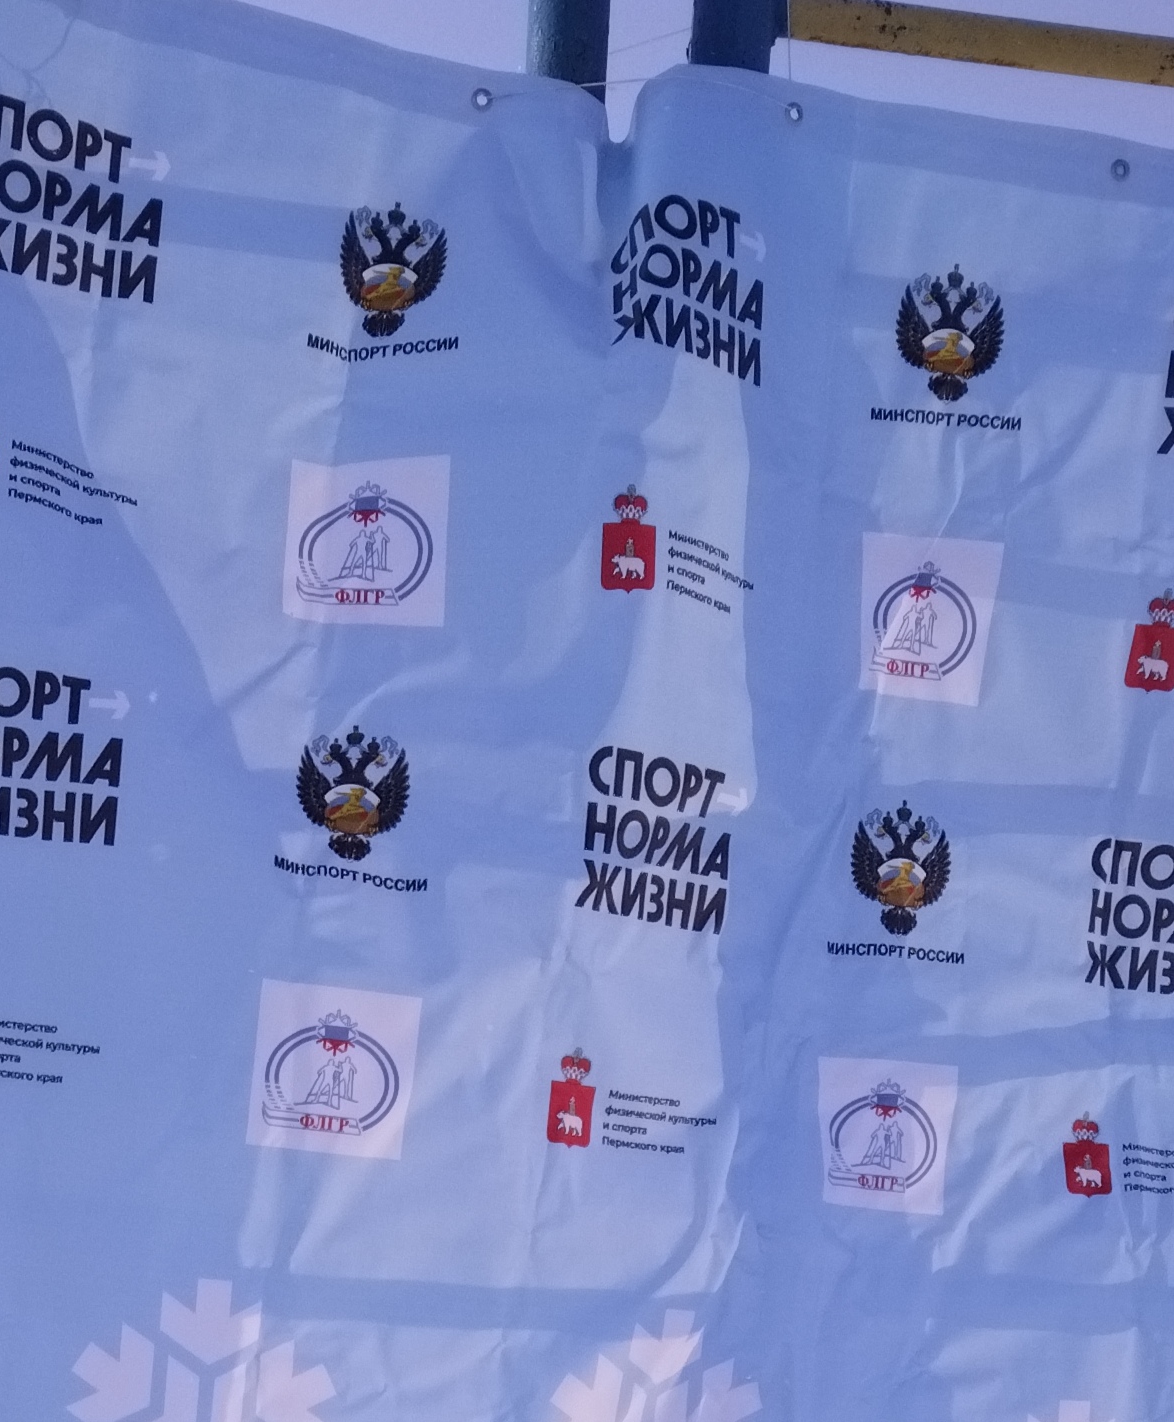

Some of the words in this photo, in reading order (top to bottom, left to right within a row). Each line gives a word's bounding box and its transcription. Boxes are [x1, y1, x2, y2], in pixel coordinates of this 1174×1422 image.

[307, 333, 388, 363] МИНСПОРТ
[393, 336, 459, 356] РОССИИ
[870, 406, 954, 427] МИНСПОРТ
[957, 412, 1022, 432] РОССИИ
[11, 439, 94, 479] Министерство
[9, 473, 17, 482] и
[20, 475, 61, 496] спорта
[10, 456, 79, 490] физической
[82, 485, 138, 506] культуры
[8, 488, 72, 518] Пермского
[74, 513, 103, 525] края
[588, 745, 725, 817] СПОРТ
[583, 802, 732, 880] НОРМА
[274, 855, 359, 882] МИНСПОРТ
[362, 872, 428, 892] РОССИИ
[575, 859, 728, 935] ЖИЗНИ
[1088, 888, 1174, 944] НОР
[826, 940, 905, 960] МИНСПОРТ
[907, 946, 965, 965] РОССИИ
[45, 1041, 101, 1055] культуры
[36, 1074, 63, 1084] края
[608, 1090, 681, 1107] Министерство
[602, 1122, 609, 1130] и
[612, 1123, 647, 1135] спорта
[605, 1105, 666, 1121] физической
[668, 1115, 717, 1127] культуры
[602, 1136, 658, 1151] Пермского
